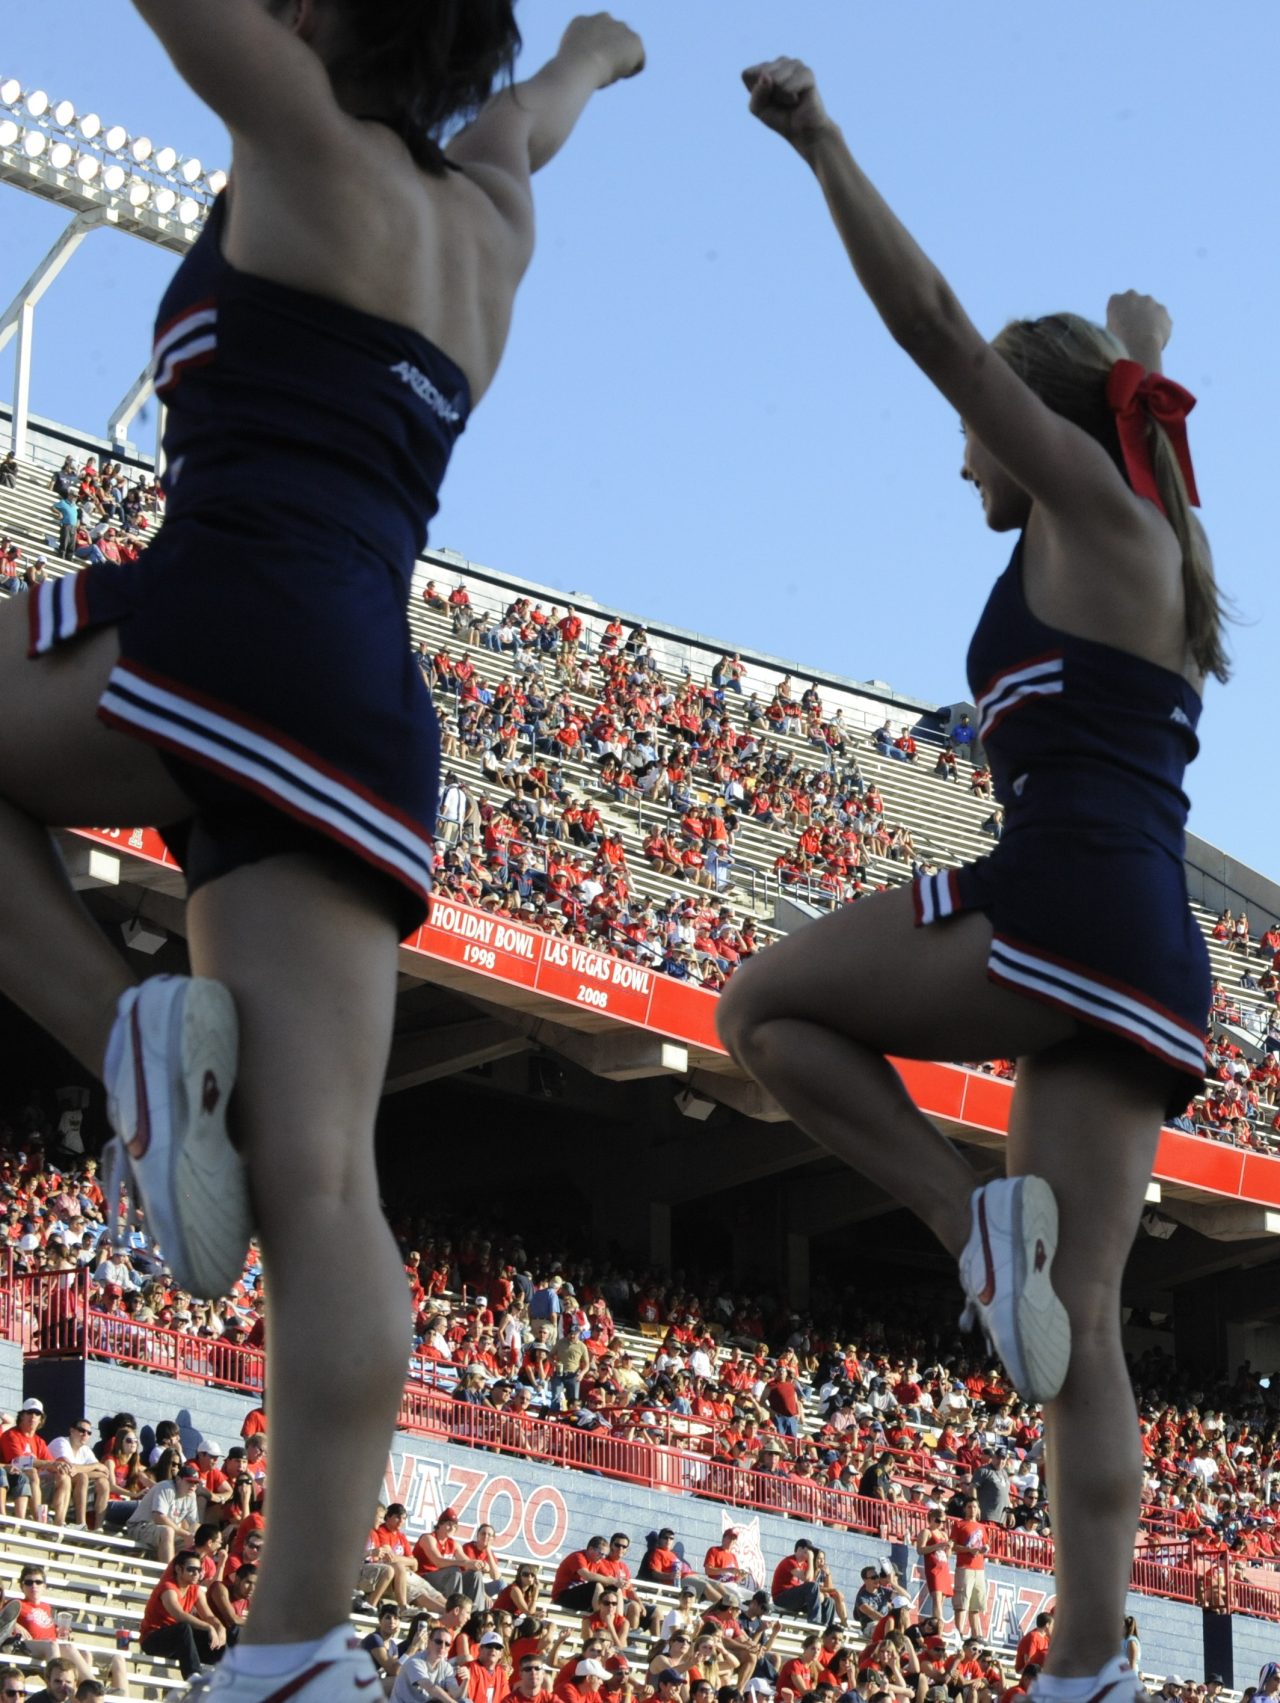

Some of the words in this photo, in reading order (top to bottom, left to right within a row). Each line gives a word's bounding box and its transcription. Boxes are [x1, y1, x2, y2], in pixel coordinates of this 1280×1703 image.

[431, 903, 493, 944] HOLIDAY
[495, 925, 534, 958] BOWL
[463, 944, 496, 970] 1998
[544, 941, 568, 966] LAS
[572, 950, 609, 980] VEGAS
[612, 964, 649, 994] BOWL
[577, 985, 608, 1008] 2008
